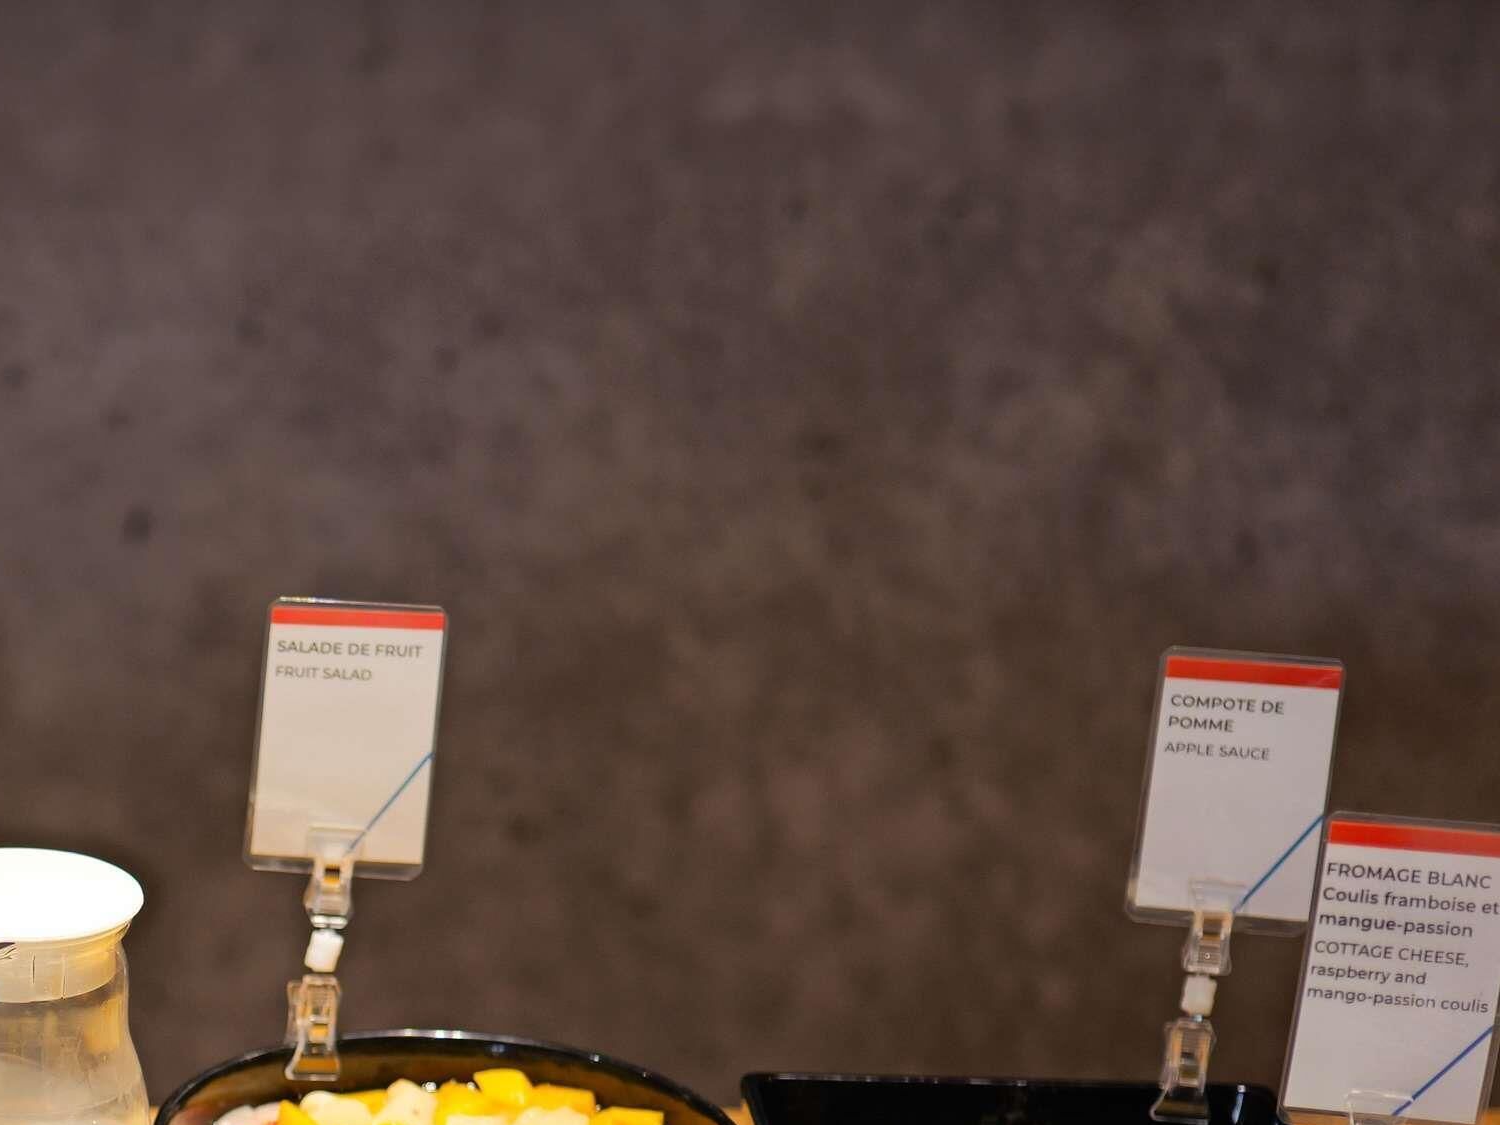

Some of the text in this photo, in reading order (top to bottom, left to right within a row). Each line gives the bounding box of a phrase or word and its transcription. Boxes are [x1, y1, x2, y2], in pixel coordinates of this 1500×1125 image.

[278, 640, 422, 658] SALADE DE FRUIT
[276, 666, 372, 681] FRUIT SALAD
[1171, 695, 1284, 714] COMPOTE DE
[1168, 716, 1234, 732] POMME
[1165, 742, 1270, 761] APPLE SAUCE
[1327, 862, 1491, 888] FROMAGE BLANC
[1323, 887, 1499, 915] Coulis framboise et
[1319, 913, 1473, 937] mangue-passion
[1315, 941, 1469, 967] COTTAGE CHEESE,
[1311, 964, 1426, 984] raspberry and
[1308, 988, 1489, 1013] mango-passion coulis
